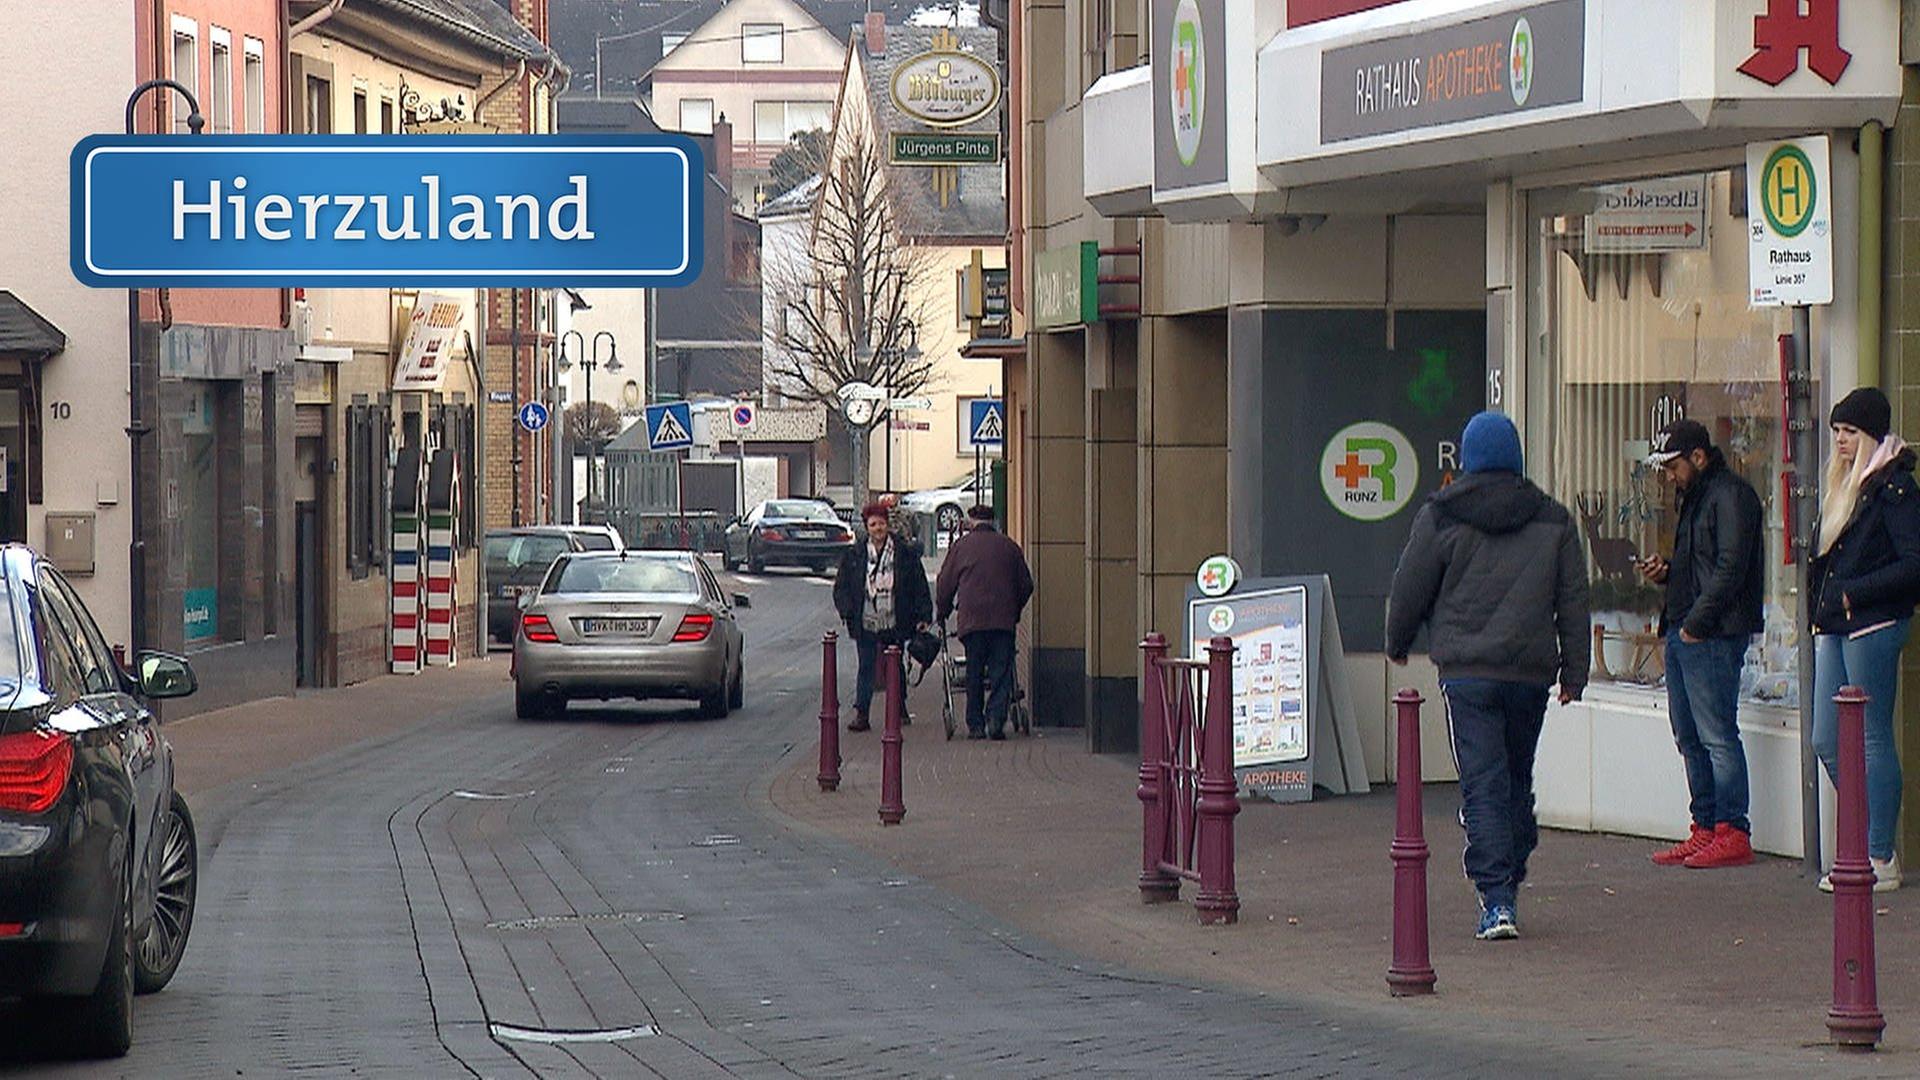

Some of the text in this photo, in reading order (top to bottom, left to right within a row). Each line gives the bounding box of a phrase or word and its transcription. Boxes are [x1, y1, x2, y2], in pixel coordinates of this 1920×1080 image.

[1355, 42, 1504, 115] RATHAUS APOTHEKE
[898, 140, 990, 157] Jürgens Pinte
[1769, 249, 1812, 265] Rathaus
[1775, 274, 1792, 285] Linie
[1489, 369, 1501, 405] 15
[50, 402, 71, 419] 10
[1243, 771, 1307, 786] APOTHEKE
